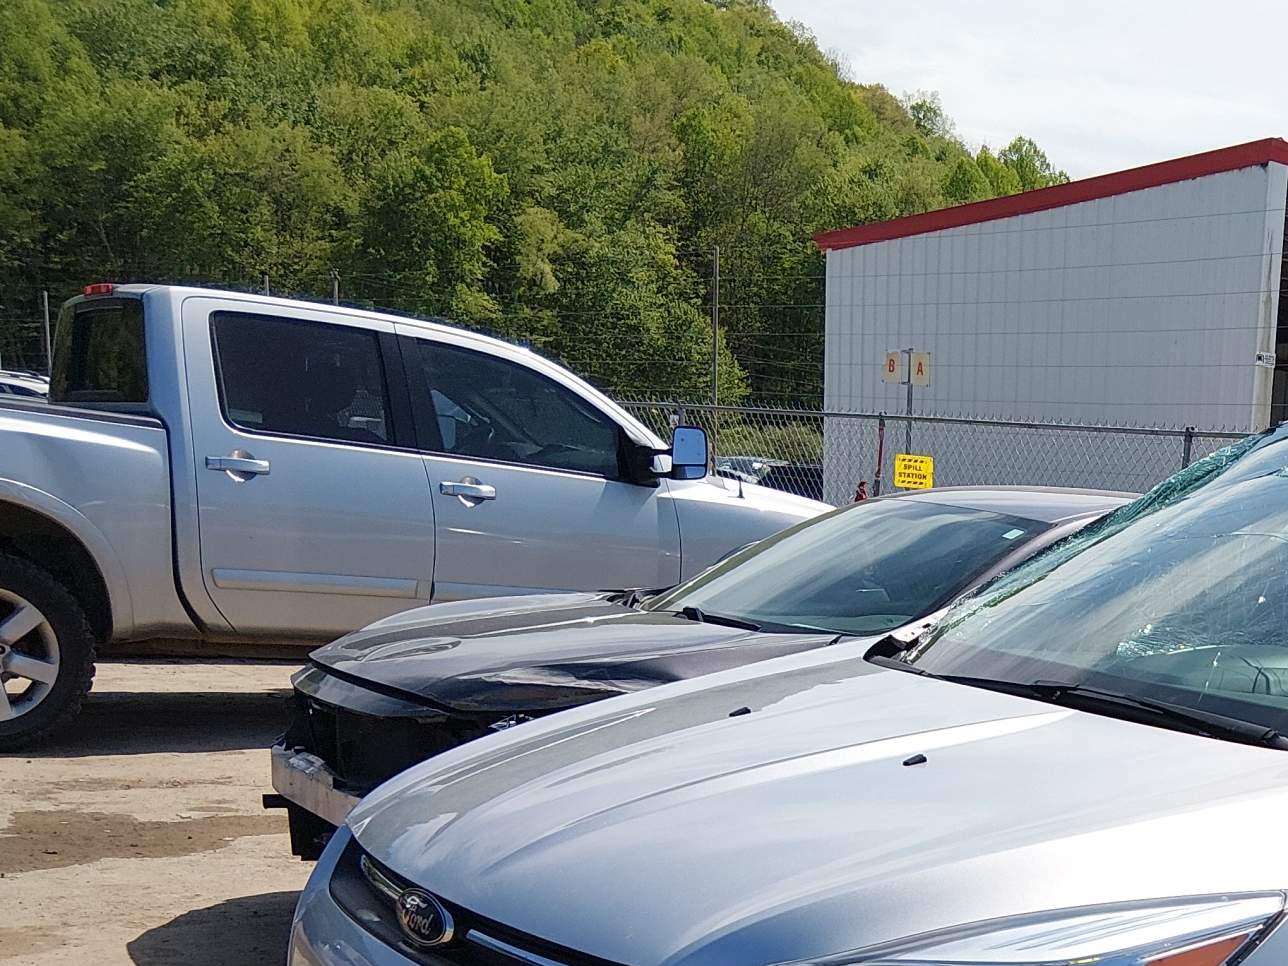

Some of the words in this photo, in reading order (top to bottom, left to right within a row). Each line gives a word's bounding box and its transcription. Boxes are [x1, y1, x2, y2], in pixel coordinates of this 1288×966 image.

[888, 359, 895, 373] B
[916, 362, 924, 376] A
[903, 463, 923, 472] SPILL
[898, 472, 927, 480] STATION
[402, 895, 433, 936] Ford
